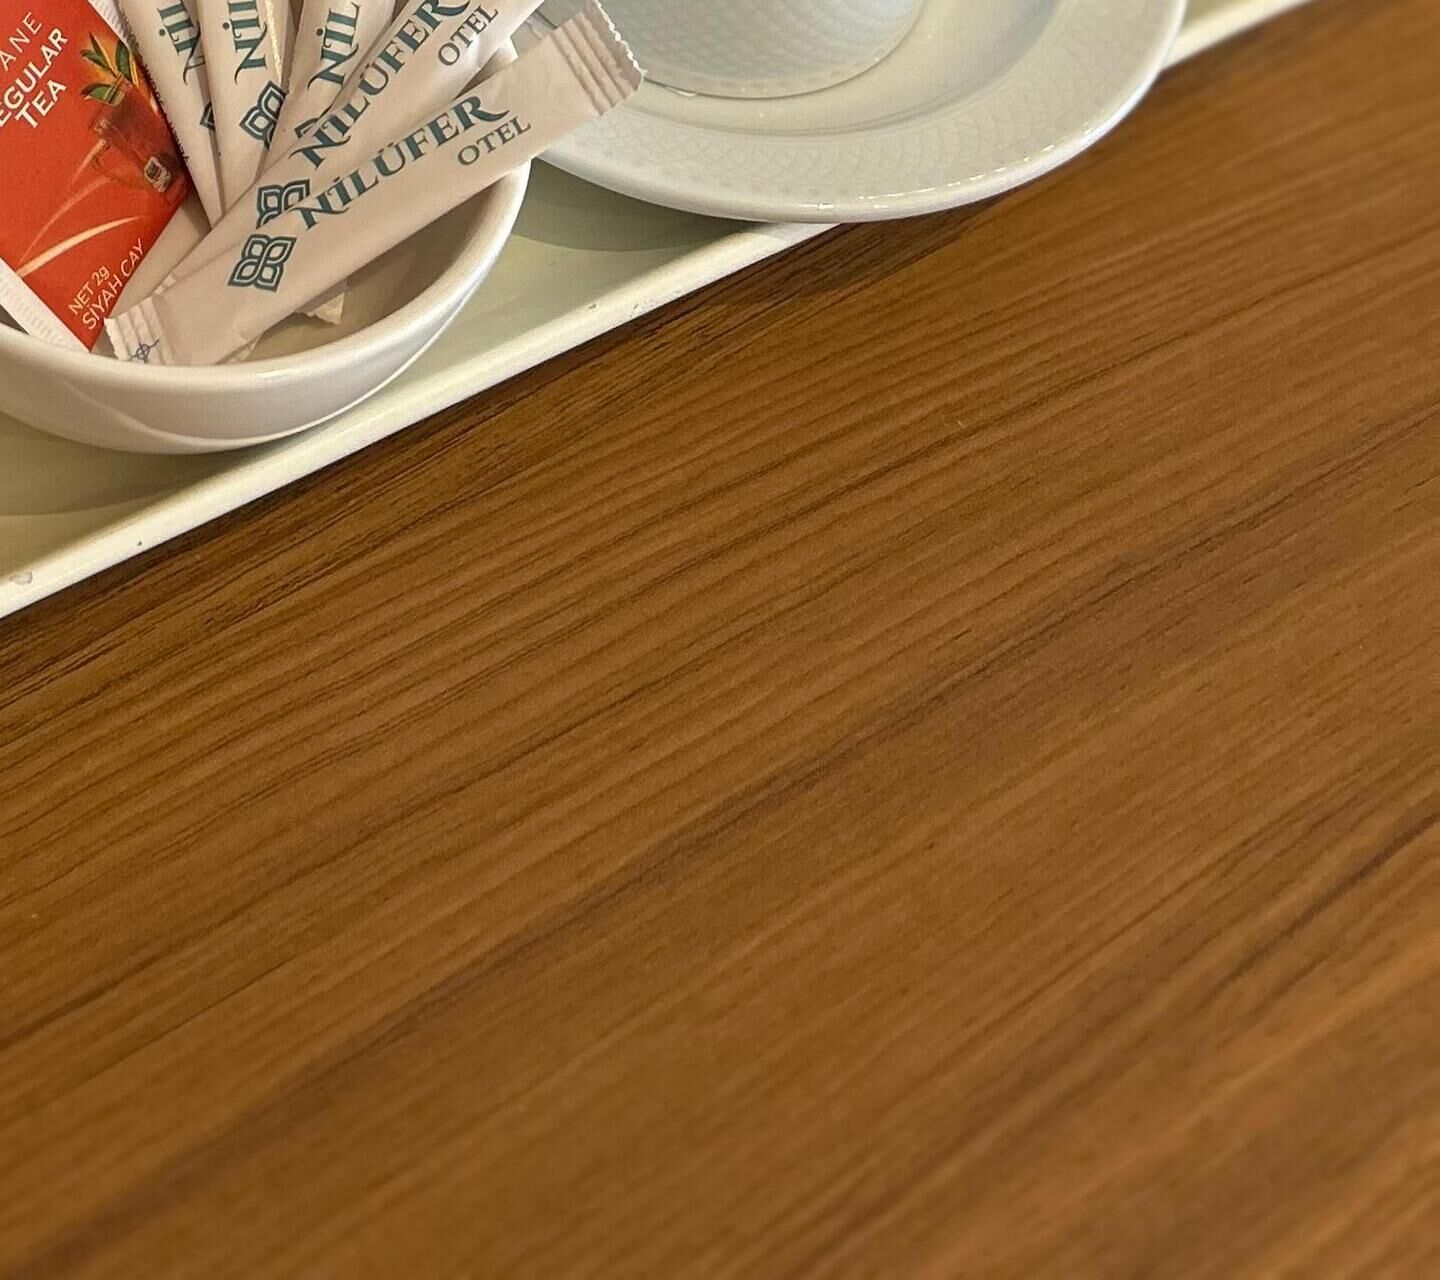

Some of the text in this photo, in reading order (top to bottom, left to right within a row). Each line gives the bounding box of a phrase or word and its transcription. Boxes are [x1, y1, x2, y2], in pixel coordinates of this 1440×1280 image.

[437, 5, 499, 67] OTEL
[14, 78, 68, 132] TEA
[292, 93, 510, 230] NİLÜFER
[457, 116, 532, 167] OTEL
[68, 282, 94, 316] NET
